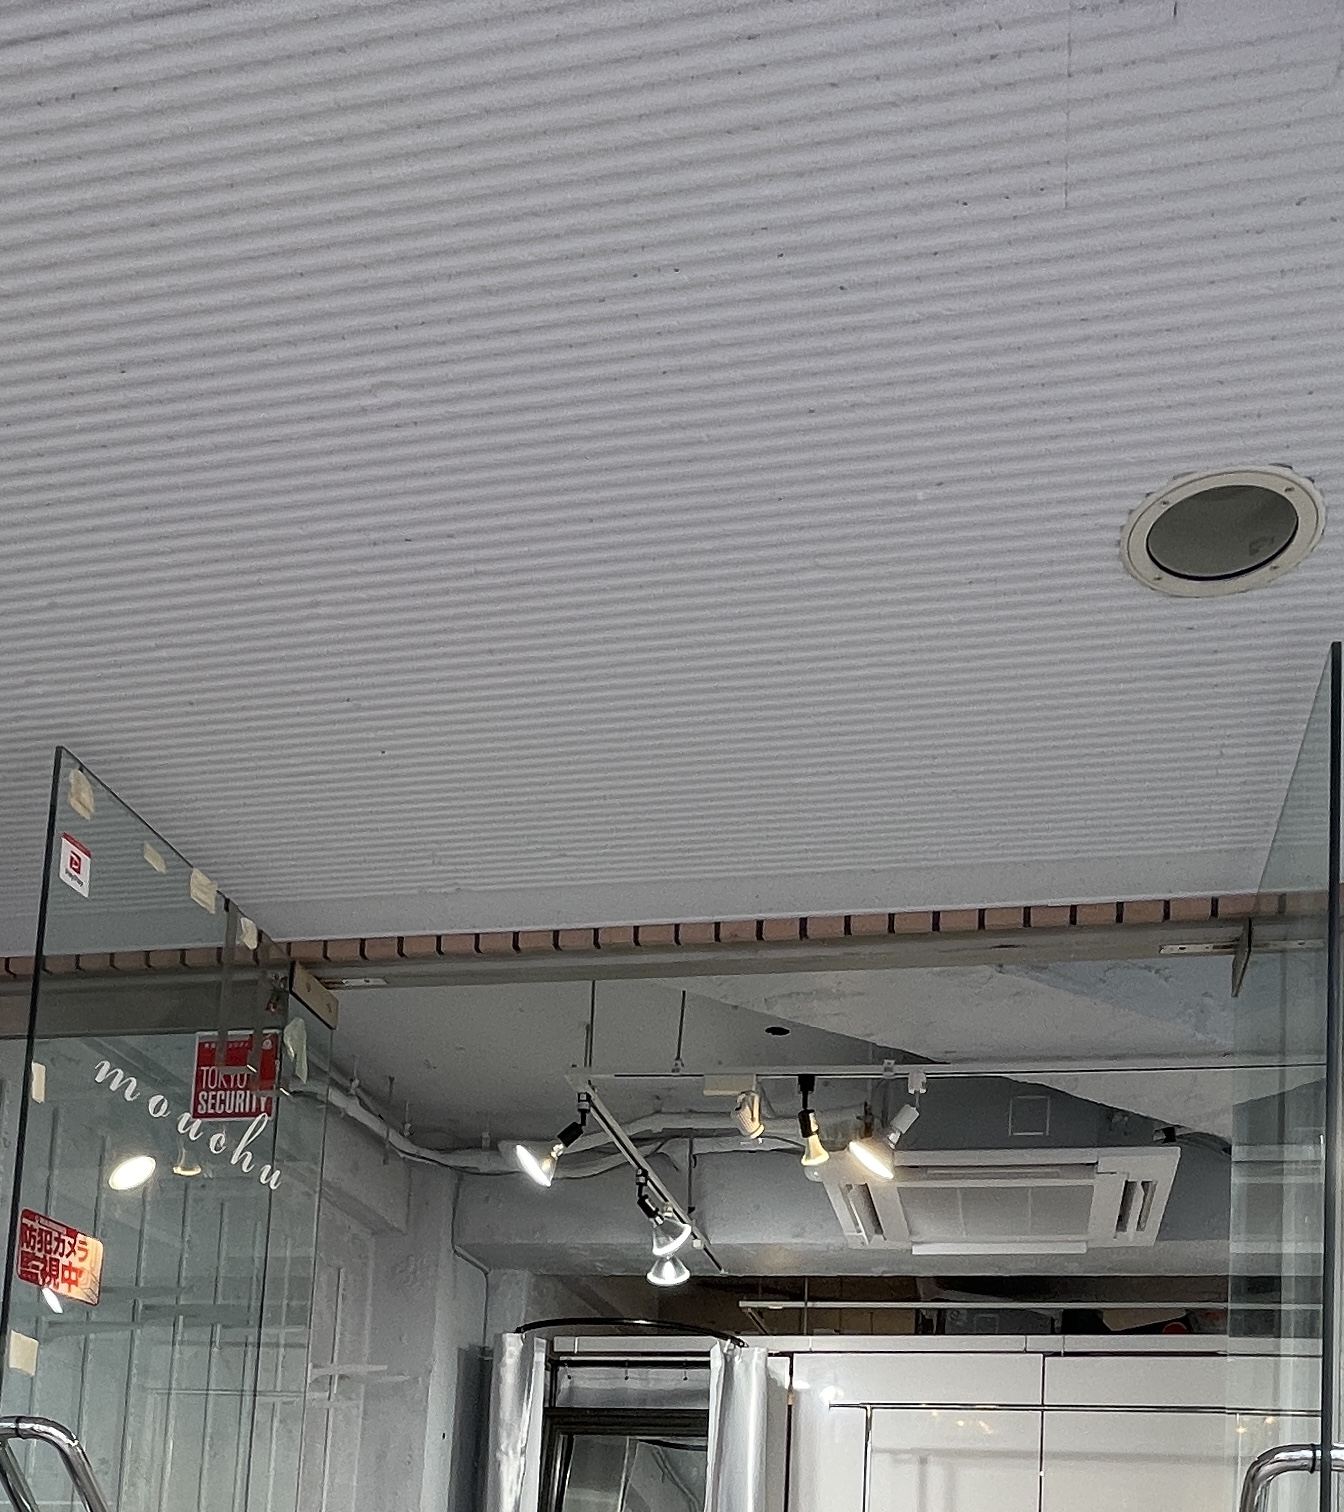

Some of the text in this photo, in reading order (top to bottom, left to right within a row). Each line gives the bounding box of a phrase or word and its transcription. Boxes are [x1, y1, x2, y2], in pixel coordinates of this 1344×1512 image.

[197, 1090, 268, 1114] SECURITY
[20, 1222, 90, 1263] 防犯カメラ
